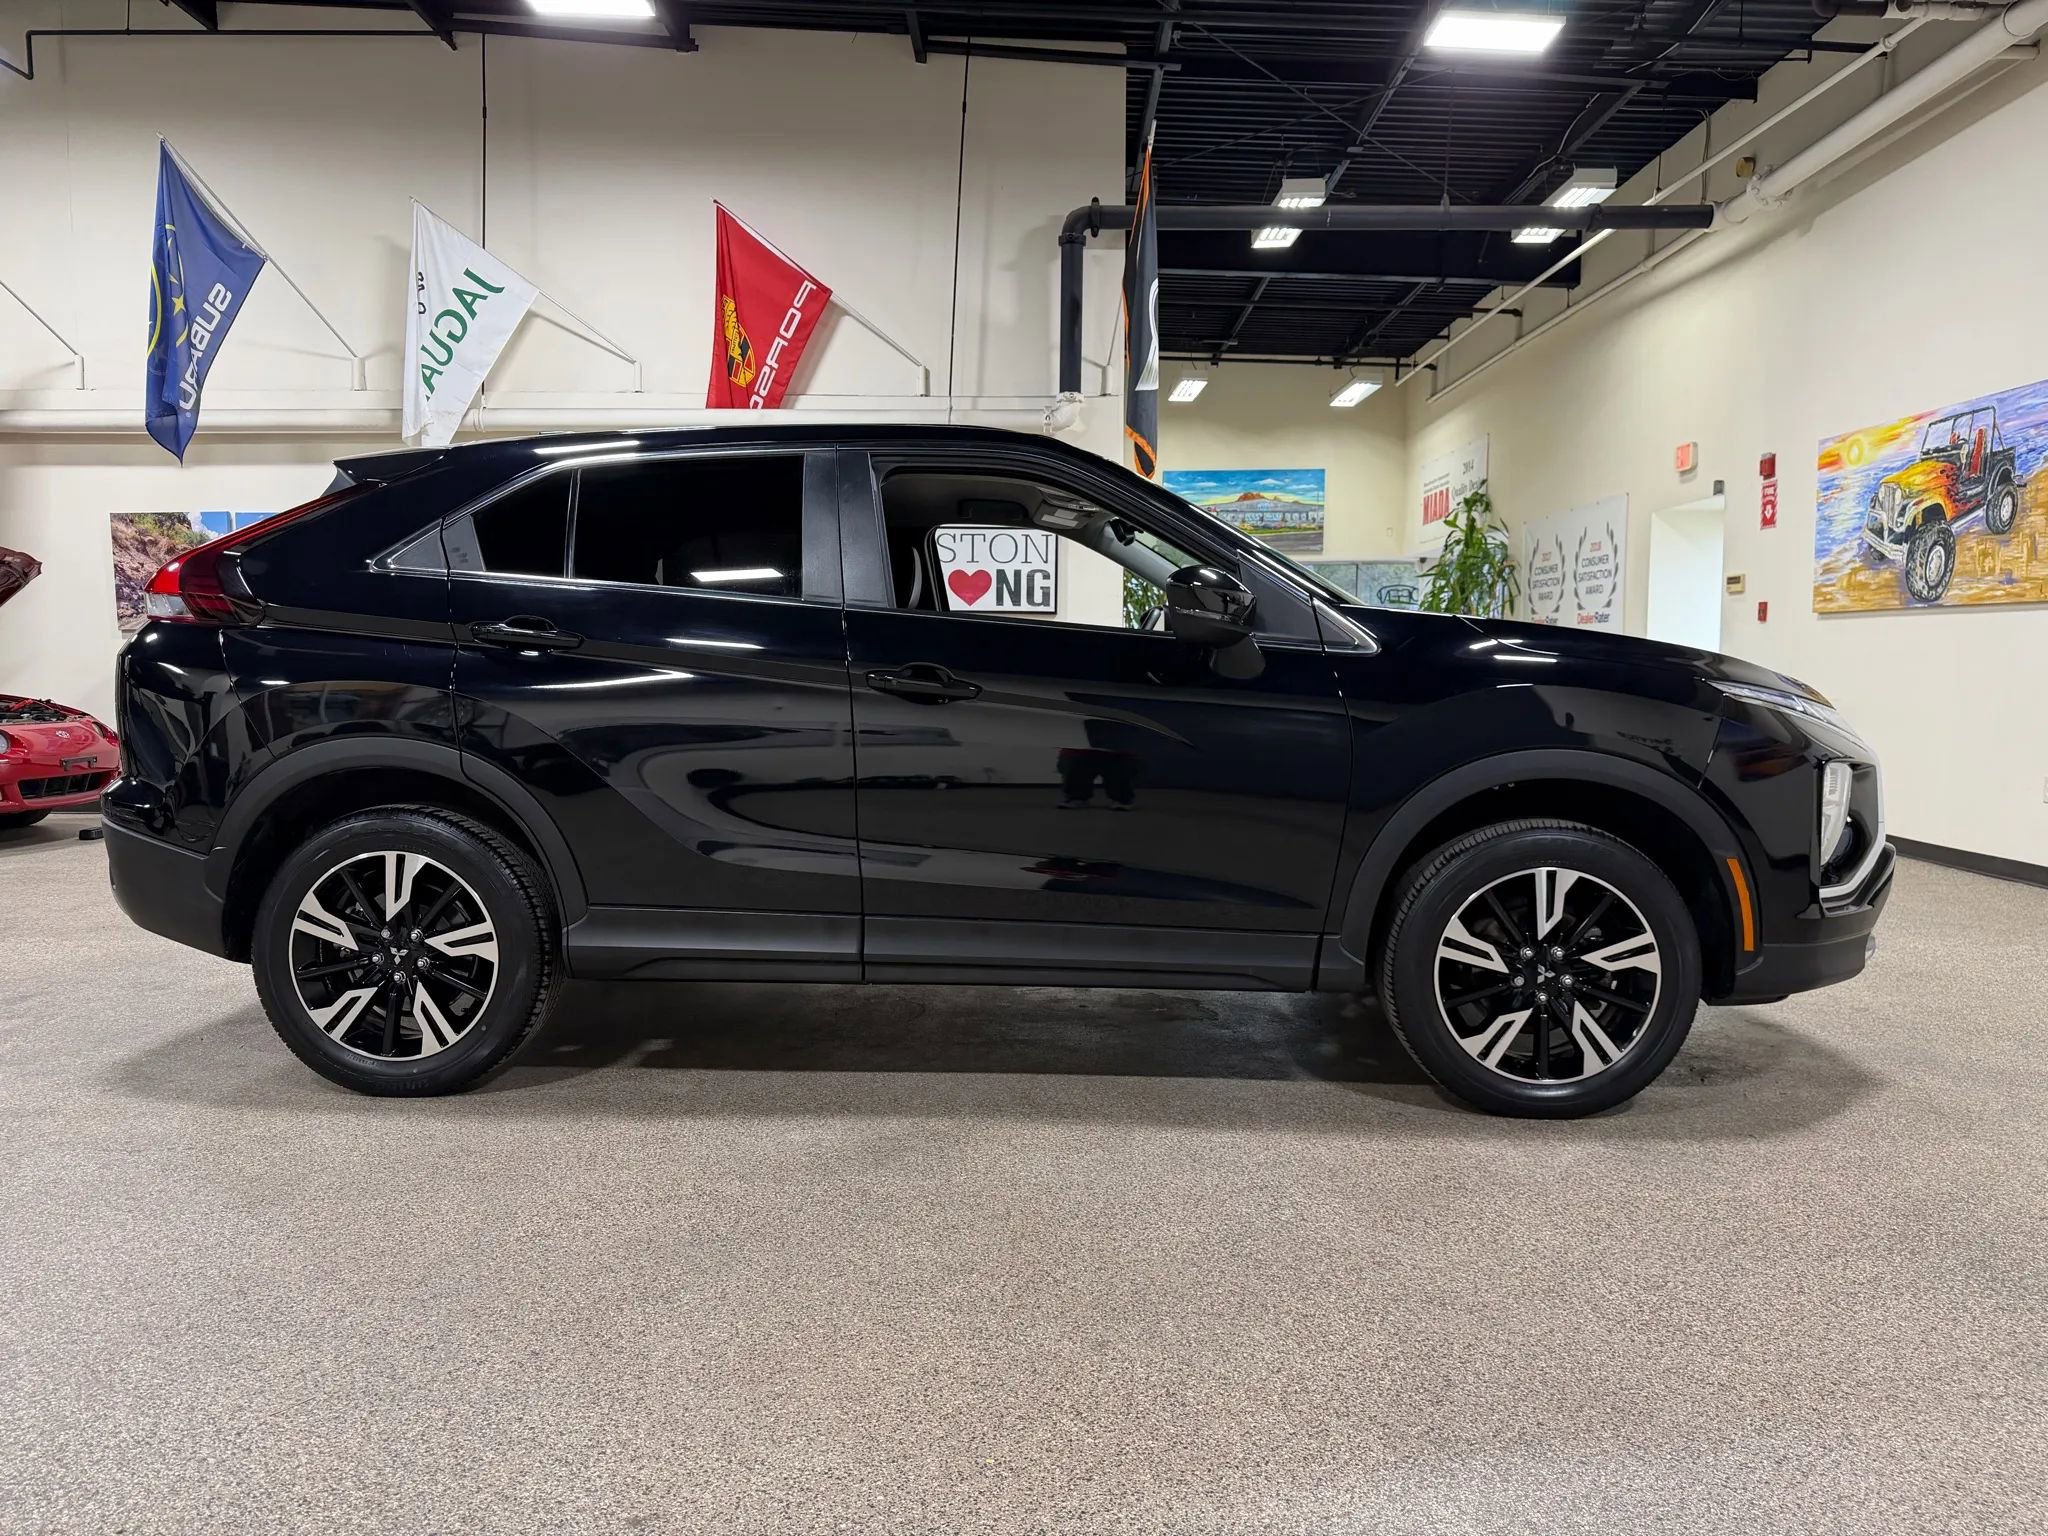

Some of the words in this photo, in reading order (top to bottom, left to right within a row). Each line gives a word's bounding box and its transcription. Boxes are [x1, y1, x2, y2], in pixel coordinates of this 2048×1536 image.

[1581, 554, 1609, 568] CONSUMER
[1534, 564, 1558, 576] CONSUMER
[1578, 569, 1612, 582] SATISFACTION
[1532, 577, 1560, 589] SATISFACTION
[1538, 591, 1553, 600] AWARD
[1585, 584, 1604, 595] AWARD
[1577, 611, 1610, 624] DealerRater
